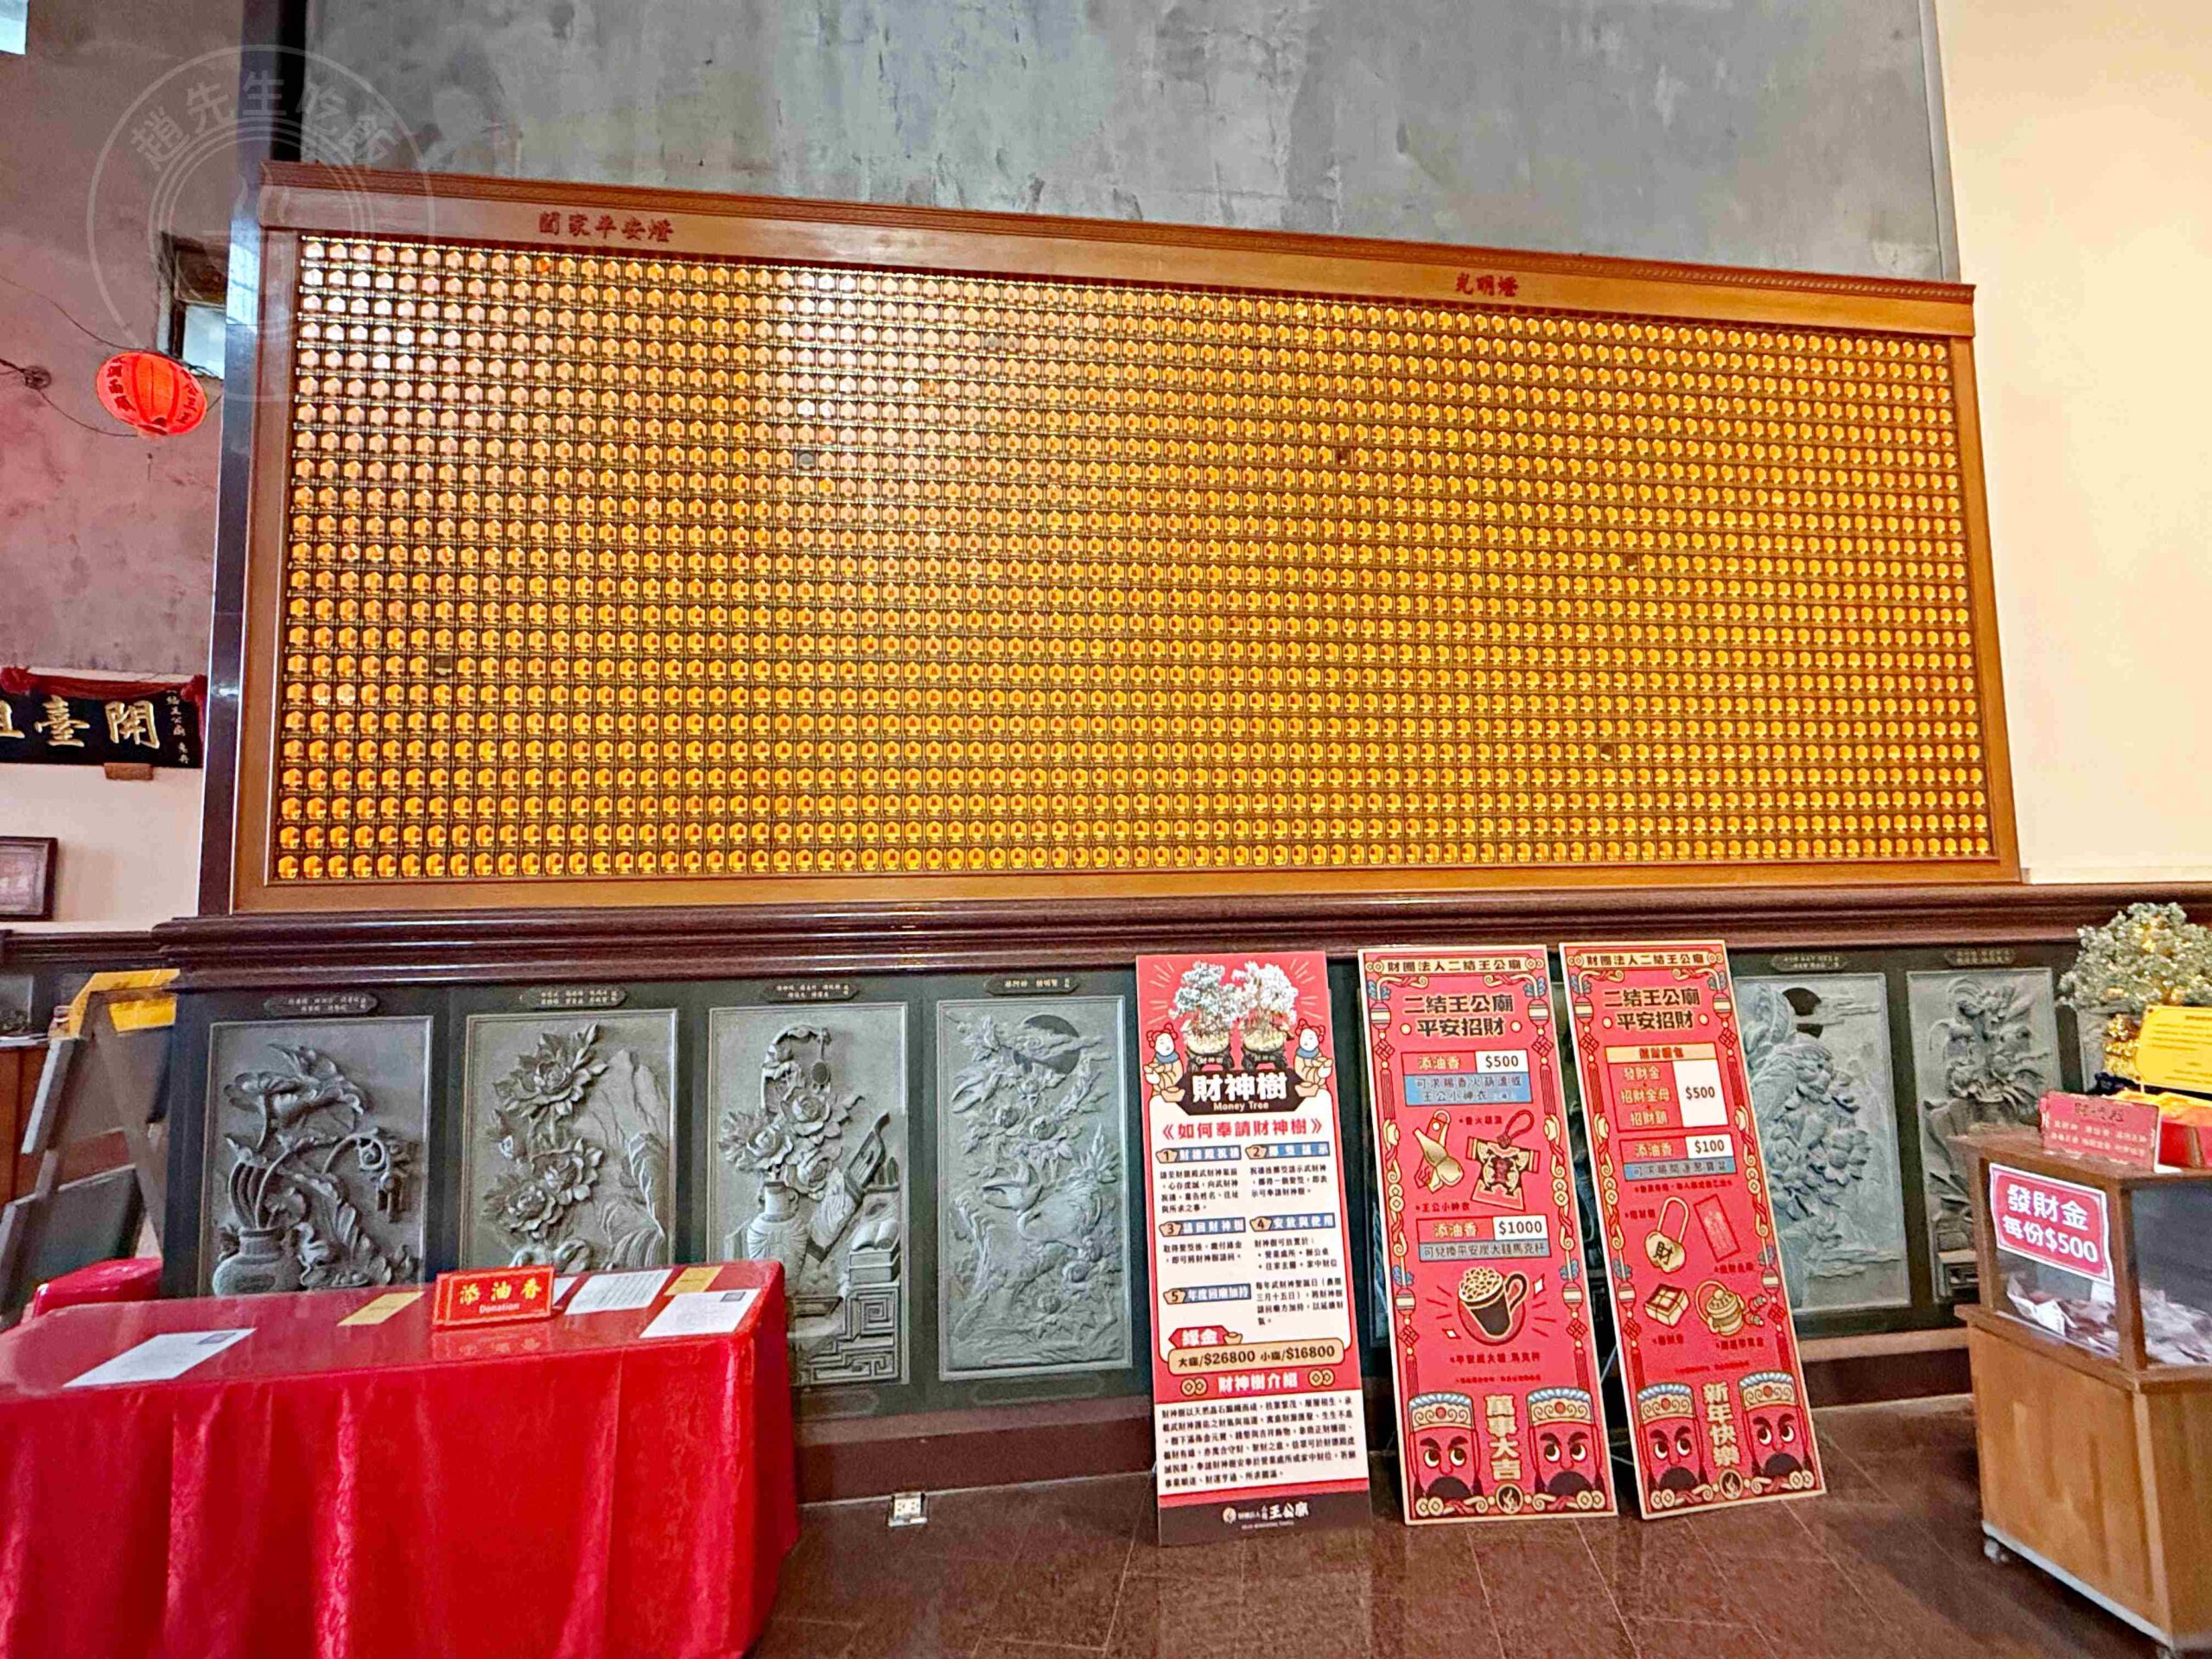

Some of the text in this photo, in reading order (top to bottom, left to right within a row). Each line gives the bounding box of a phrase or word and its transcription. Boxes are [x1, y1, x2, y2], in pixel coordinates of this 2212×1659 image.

[1456, 272, 1518, 297] 光明燈
[1388, 958, 1522, 972] 財團法人二結王公廟
[1586, 954, 1705, 966] 財團法人二結王公廟
[1404, 994, 1514, 1014] 二結王公廟
[1604, 988, 1700, 1007] 二結王公廟
[1417, 1017, 1504, 1037] 平安招財
[1617, 1010, 1694, 1031] 平安招財
[1418, 1056, 1460, 1071] 添油香
[1484, 1055, 1519, 1069] $500
[1624, 1066, 1660, 1081] 發財金
[1192, 1071, 1287, 1103] 財神樹
[1685, 1086, 1715, 1100] $500
[1213, 1101, 1269, 1112] Money Tree
[1253, 1147, 1261, 1157] 2
[1635, 1141, 1673, 1158] 添油香
[1694, 1139, 1725, 1154] $100
[1164, 1151, 1169, 1160] 1
[2006, 1184, 2088, 1231] 發財金
[1166, 1224, 1174, 1234] 3
[1257, 1218, 1265, 1229] 4
[1433, 1221, 1478, 1238] 添油香
[1498, 1220, 1542, 1236] $1000
[2003, 1216, 2099, 1263] 每份$500
[460, 1277, 542, 1306] 添油香
[1171, 1291, 1179, 1301] 5
[479, 1303, 520, 1313] Donation
[1217, 1372, 1298, 1393] 財神樹介紹
[1702, 1382, 1740, 1466] 新年快樂
